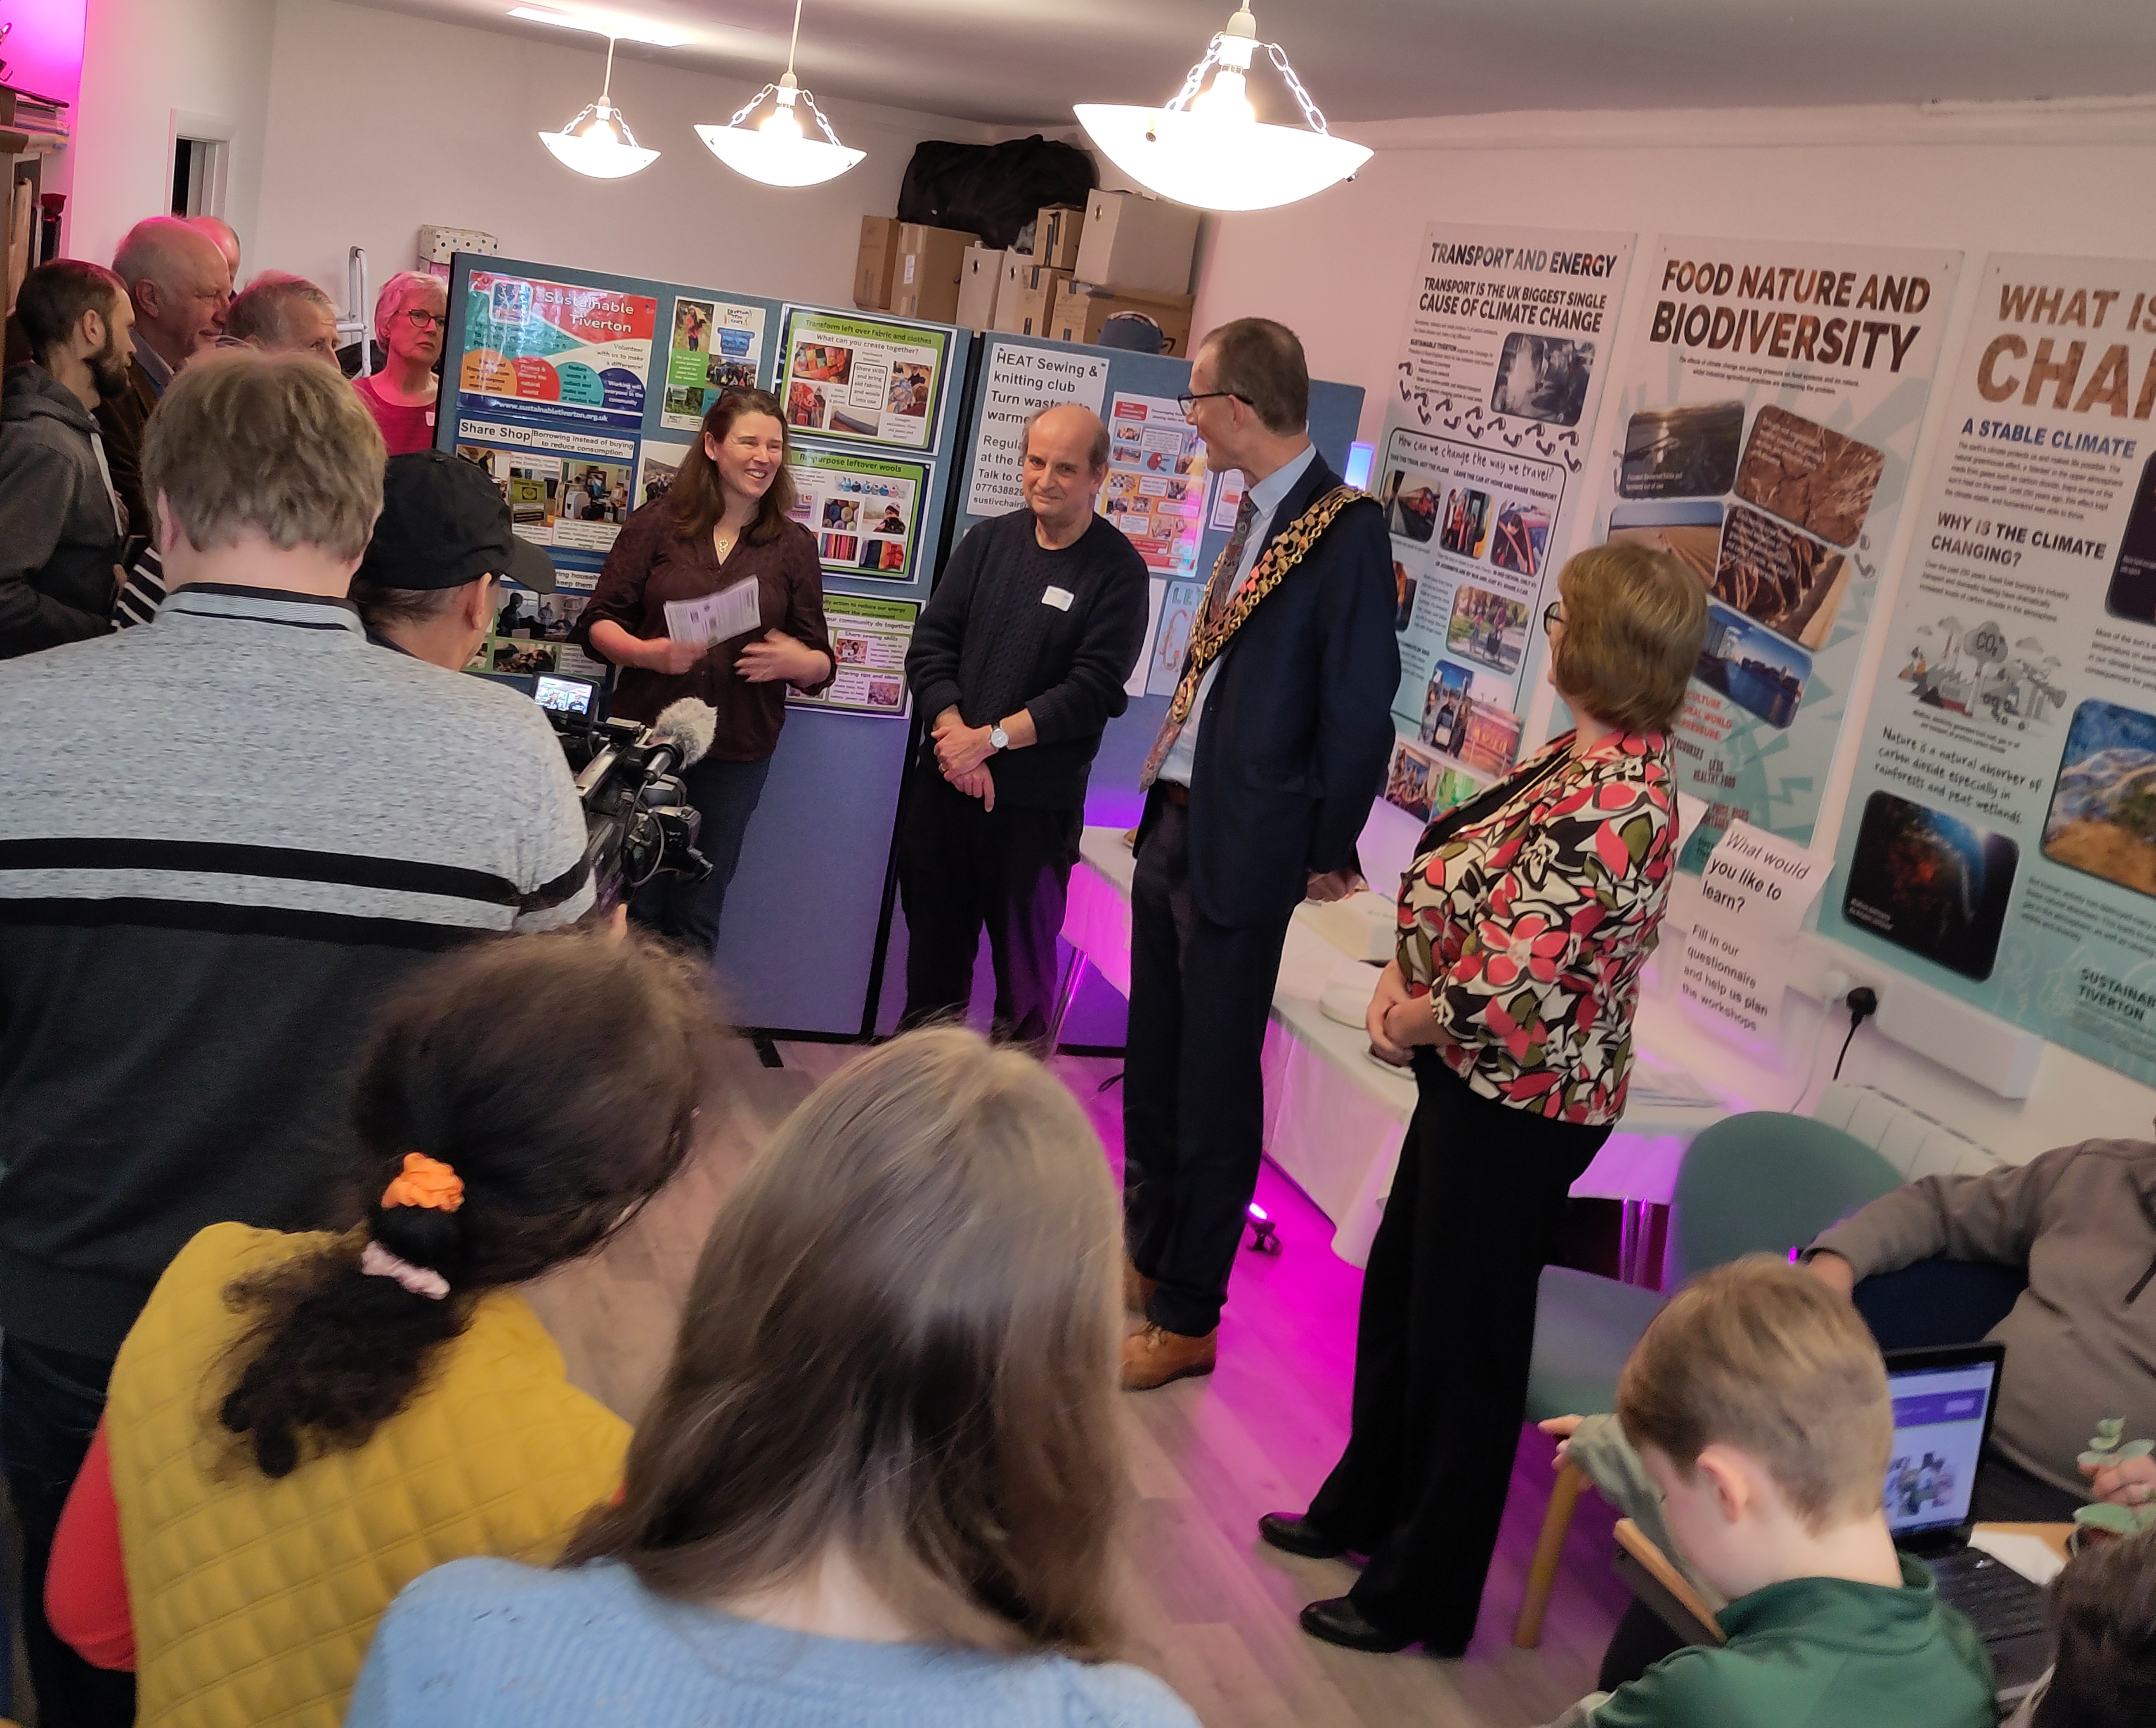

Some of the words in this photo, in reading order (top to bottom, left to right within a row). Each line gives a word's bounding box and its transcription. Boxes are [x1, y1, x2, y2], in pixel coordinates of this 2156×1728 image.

[1431, 242, 1513, 268] TRANSPORT
[1512, 249, 1548, 271] AND
[1549, 251, 1617, 278] ENERGY
[1424, 277, 1476, 294] TRANSPORT
[1476, 283, 1485, 294] IS
[1487, 284, 1506, 299] THE
[1506, 286, 1522, 300] UK
[1522, 287, 1567, 305] BIGGEST
[1567, 291, 1607, 309] SINGLE
[1661, 259, 1734, 296] FOOD
[1737, 264, 1856, 307] NATURE
[1856, 274, 1931, 314] AND
[544, 291, 635, 316] Sustainable
[1419, 293, 1460, 315] CAUSE
[1461, 297, 1479, 316] OF
[1479, 300, 1538, 325] CLIMATE
[1539, 306, 1603, 333] CHANGE
[1998, 284, 2120, 328] WHAT
[2126, 292, 2156, 333] IS
[571, 314, 631, 333] Tiverton
[806, 320, 840, 331] Transform
[842, 324, 853, 333] left
[872, 329, 891, 339] fabric
[907, 335, 932, 345] clothes
[1650, 300, 1922, 373] BIODIVERSITY
[614, 343, 643, 352] Volunteer
[816, 333, 834, 343] What
[849, 339, 862, 348] you
[863, 341, 885, 350] create
[887, 343, 919, 355] together?
[994, 370, 1043, 391] knitting
[1047, 378, 1076, 392] club
[996, 352, 1033, 368] HEAT
[1037, 358, 1085, 378] Sewing
[1088, 365, 1098, 377] &
[991, 390, 1019, 405] Turn
[461, 422, 496, 436] Share
[499, 428, 531, 442] Shop
[534, 430, 570, 442] Borrowing
[572, 436, 598, 444] instead
[610, 440, 634, 450] buying
[1961, 418, 1974, 435] A
[1979, 420, 2047, 445] STABLE
[2051, 430, 2137, 459] CLIMATE
[551, 442, 575, 450] reduce
[577, 446, 623, 456] consumption
[981, 453, 992, 463] at
[995, 454, 1013, 465] the
[1414, 441, 1427, 451] can
[1430, 445, 1439, 456] we
[1442, 444, 1470, 466] change
[1472, 452, 1486, 467] the
[1489, 459, 1506, 475] way
[1508, 463, 1519, 475] we
[1522, 463, 1554, 482] travel?
[846, 459, 877, 470] leftover
[879, 464, 901, 473] wools
[979, 468, 999, 480] Talk
[1002, 472, 1012, 481] to
[1931, 534, 2022, 568] CHANGING?
[1937, 511, 1972, 532] WHY
[1975, 519, 1991, 536] IS
[1996, 523, 2028, 544] THE
[2031, 531, 2107, 560] CLIMATE
[839, 618, 873, 626] community
[1704, 712, 1732, 730] WORLD
[1878, 747, 1910, 766] carbon
[1913, 754, 1945, 779] dioxide
[1948, 769, 1998, 800] especially
[2000, 789, 2010, 799] in
[1883, 726, 1917, 749] Nature
[1920, 738, 1927, 753] is
[1929, 746, 1936, 755] a
[1939, 748, 1977, 770] natural
[1979, 762, 2026, 787] absorber
[2029, 778, 2043, 794] of
[1875, 762, 1924, 789] rainforests
[1927, 782, 1946, 797] and
[1948, 790, 1972, 808] peat
[1726, 832, 1762, 860] What
[1764, 849, 1811, 880] would
[1708, 857, 1735, 880] you
[1738, 868, 1764, 892] like
[1767, 882, 1782, 901] to
[1702, 881, 1746, 914] learn?
[1692, 924, 1708, 941] Fill
[1709, 931, 1719, 948] in
[1721, 941, 1740, 957] our
[1687, 946, 1756, 989] questionnaire
[1682, 983, 1697, 999] the
[1701, 995, 1758, 1032] workshops
[1684, 966, 1702, 982] and
[1704, 974, 1727, 996] help
[1730, 989, 1742, 1003] us
[1744, 995, 1768, 1016] plan
[2080, 986, 2144, 1020] TIVERTON
